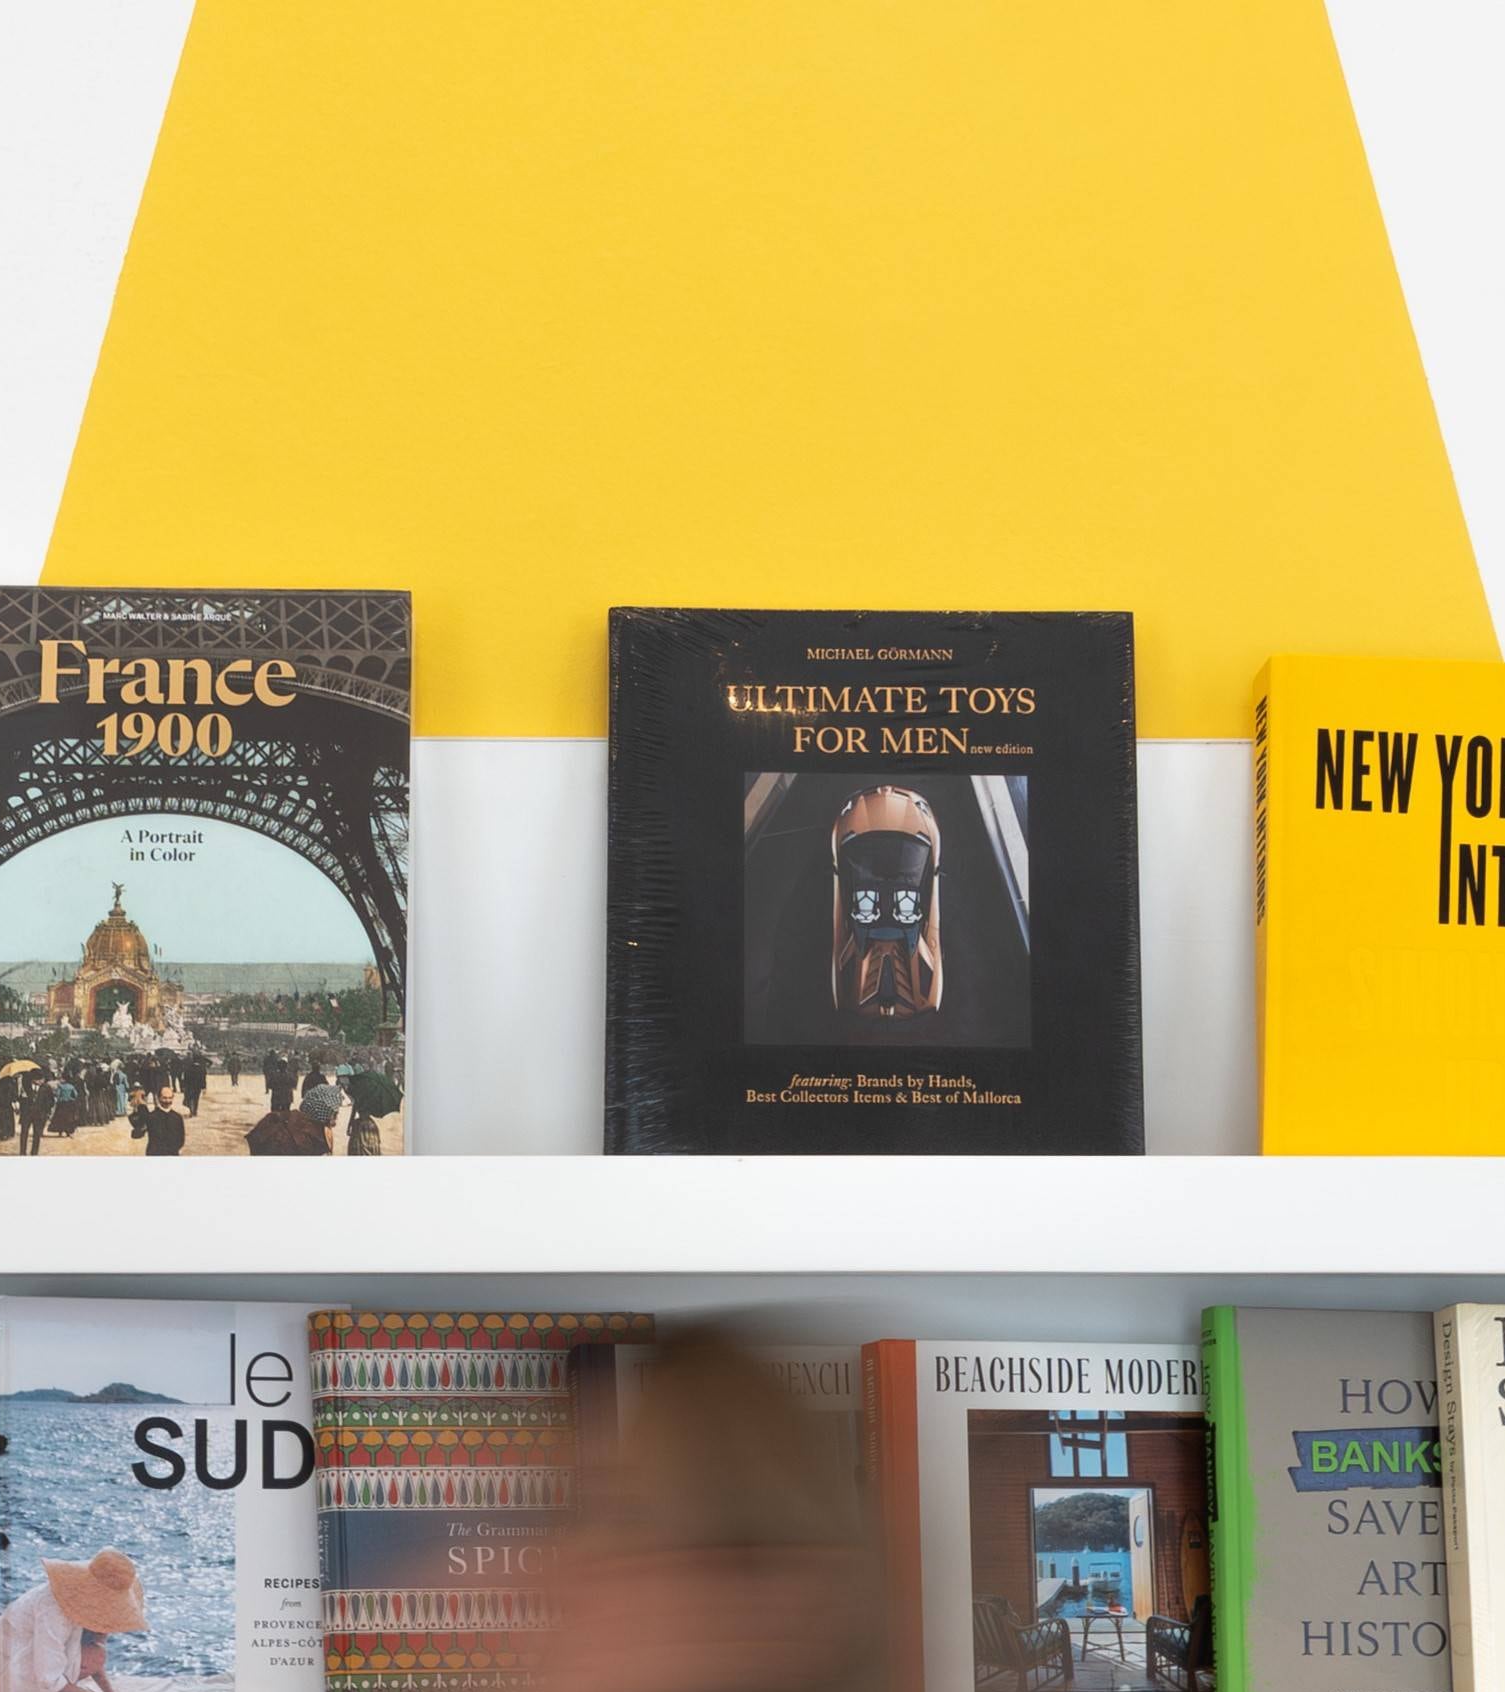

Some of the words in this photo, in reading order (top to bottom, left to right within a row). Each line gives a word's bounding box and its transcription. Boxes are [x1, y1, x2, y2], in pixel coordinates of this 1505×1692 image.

[102, 611, 128, 621] MARC
[128, 611, 162, 622] WALTER
[163, 612, 170, 621] &
[171, 612, 202, 622] SABINE
[806, 648, 874, 661] MICHAEL
[877, 646, 953, 661] GÖRMANN
[37, 639, 297, 707] France
[726, 685, 928, 714] ULTIMATE
[939, 686, 1036, 715] TOYS
[96, 712, 233, 758] 1900
[793, 726, 870, 754] FOR
[880, 727, 970, 755] MEN
[995, 743, 1034, 755] edition
[1314, 727, 1419, 815] NEW
[120, 829, 134, 844] A
[137, 828, 204, 845] Portrait
[129, 846, 146, 862] in
[149, 846, 197, 863] Color
[788, 1073, 852, 1090] featuring:
[857, 1073, 903, 1088] Brands
[907, 1073, 924, 1090] by
[928, 1074, 976, 1090] Hands,
[746, 1090, 776, 1104] Best
[780, 1090, 849, 1104] Collectors
[853, 1090, 892, 1104] Items
[895, 1091, 907, 1104] &
[911, 1091, 942, 1104] Best
[945, 1091, 959, 1104] of
[963, 1091, 1022, 1105] Mallorca
[228, 1331, 295, 1408] le
[934, 1355, 1092, 1396] BEACHSIDE
[131, 1416, 316, 1492] SUD
[263, 1577, 320, 1589] RECIPES
